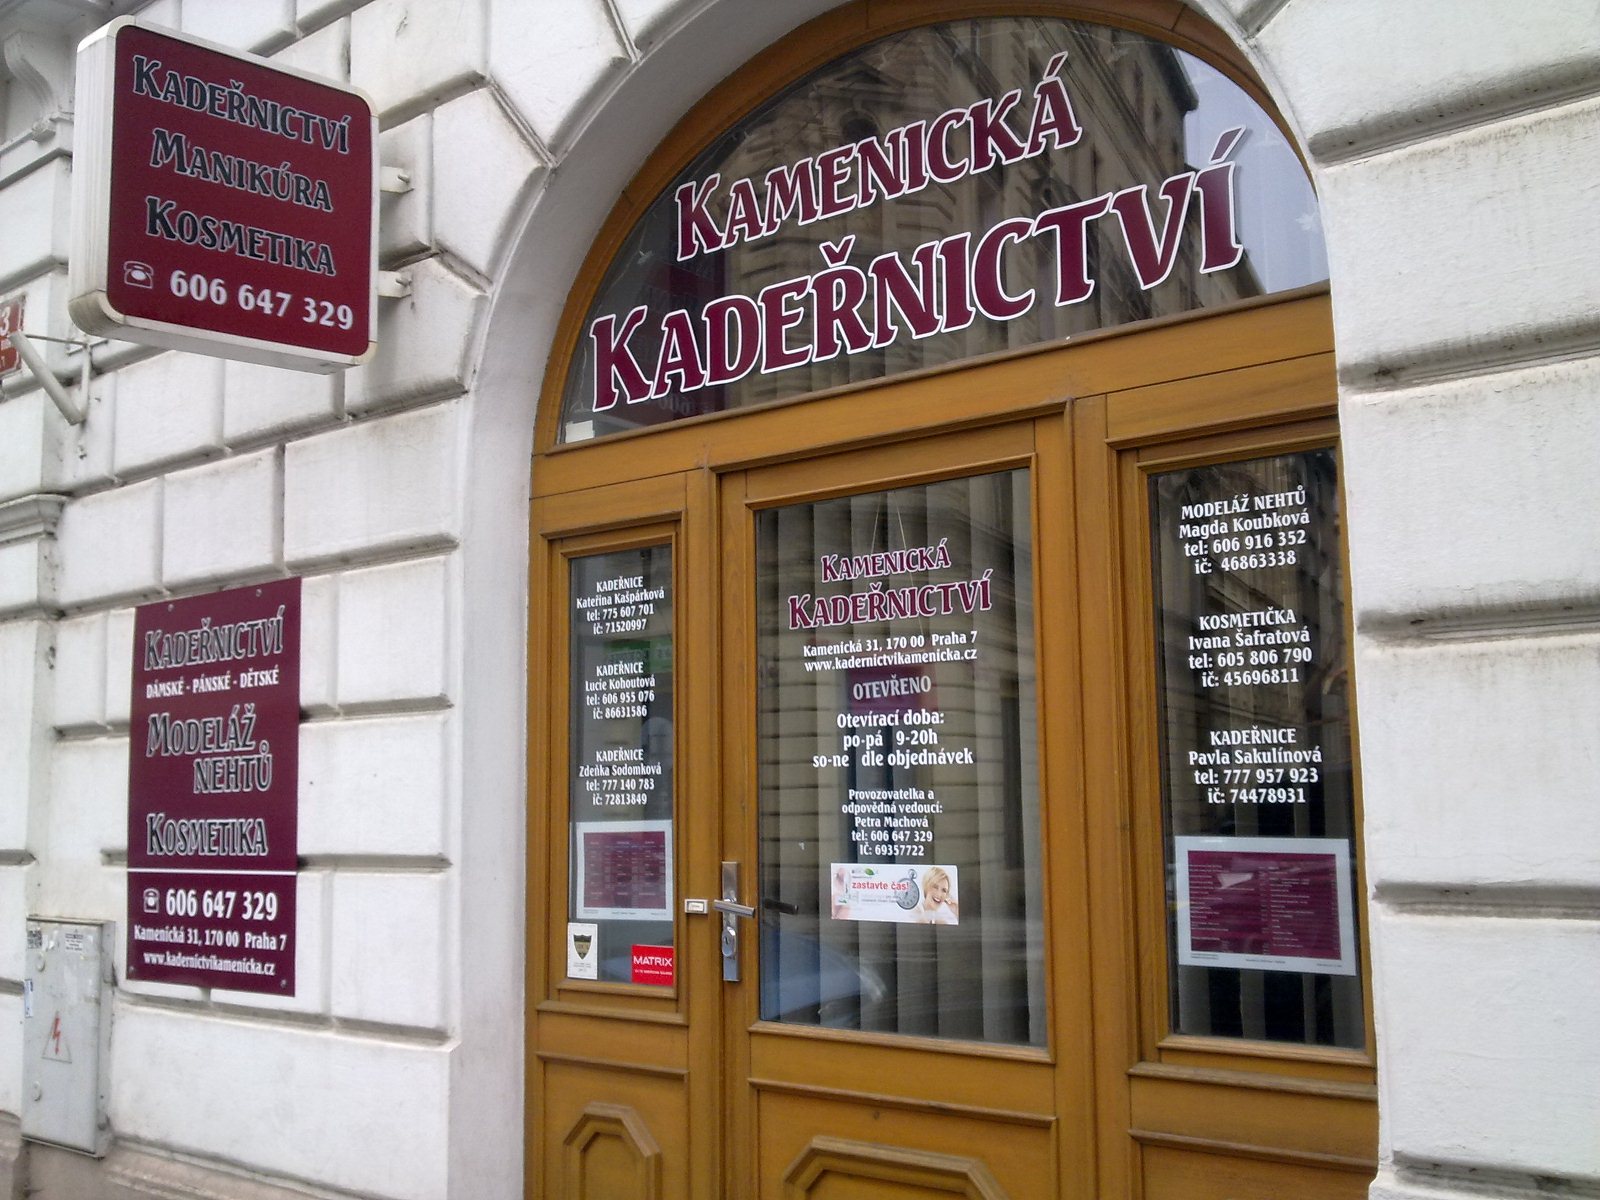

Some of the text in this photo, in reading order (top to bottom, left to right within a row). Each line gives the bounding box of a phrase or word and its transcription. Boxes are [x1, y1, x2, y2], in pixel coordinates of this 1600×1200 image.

[170, 269, 354, 330] 606 647 329
[1181, 485, 1306, 520] MODELÁŽ NEHTŮ
[1179, 508, 1310, 540] Magda Koubková
[1184, 530, 1306, 557] tel: 606 916 352
[1194, 550, 1296, 575] ič: 46863338
[596, 576, 644, 593] KADEŘNICE
[576, 586, 665, 610] Kateřina Kašpárková
[586, 603, 654, 622] tel: 775 607 701
[1200, 606, 1296, 631] KOSMETIČKA
[606, 619, 647, 634] 71520997
[804, 631, 978, 658] Kamenická 31, 170 00 Praha 7
[1189, 626, 1310, 650] Ivana Šafratová
[804, 648, 978, 671] www.kadernictvikamenicka.cz
[1189, 647, 1312, 669] tel: 605 806 790
[596, 660, 644, 677] KADEŘNICE
[1202, 668, 1299, 688] ič: 45696811
[146, 676, 184, 698] DÁMSKÉ
[192, 670, 231, 693] PÁNSKÉ
[240, 664, 279, 688] DĚTSKÉ
[585, 674, 655, 692] Lucie Kohoutová
[853, 674, 932, 701] OTEVŘENO
[586, 690, 655, 706] tel: 606 955 076
[605, 705, 647, 719] 86631586
[836, 709, 945, 729] Otevírací doba:
[896, 728, 938, 746] 9-20h
[1210, 725, 1297, 746] KADEŘNICE
[596, 747, 644, 762] KADEŘNICE
[862, 750, 884, 767] dle
[888, 748, 974, 769] objednávek
[1188, 746, 1322, 766] Pavla Sakulínová
[579, 762, 662, 777] Zdeňka Sodomková
[1194, 768, 1318, 785] tel: 777 957 923
[586, 778, 655, 791] tel: 777 140 783
[848, 788, 935, 800] Provozovatelka a
[605, 793, 647, 806] 72813849
[1208, 788, 1306, 804] ič: 74478931
[842, 801, 943, 817] odpovědná vedoucí:
[854, 816, 929, 828] Petra Machová
[852, 830, 933, 842] tel: 606 647 329
[860, 842, 925, 856] IČ: 69357722
[852, 881, 888, 890] zastavte
[166, 888, 278, 921] 606 647 329
[134, 924, 287, 951] Kamenická 31, 170 00 Praha 7
[144, 951, 276, 976] www.kadernictvikamenicka.cz
[634, 956, 673, 967] MATRIX
